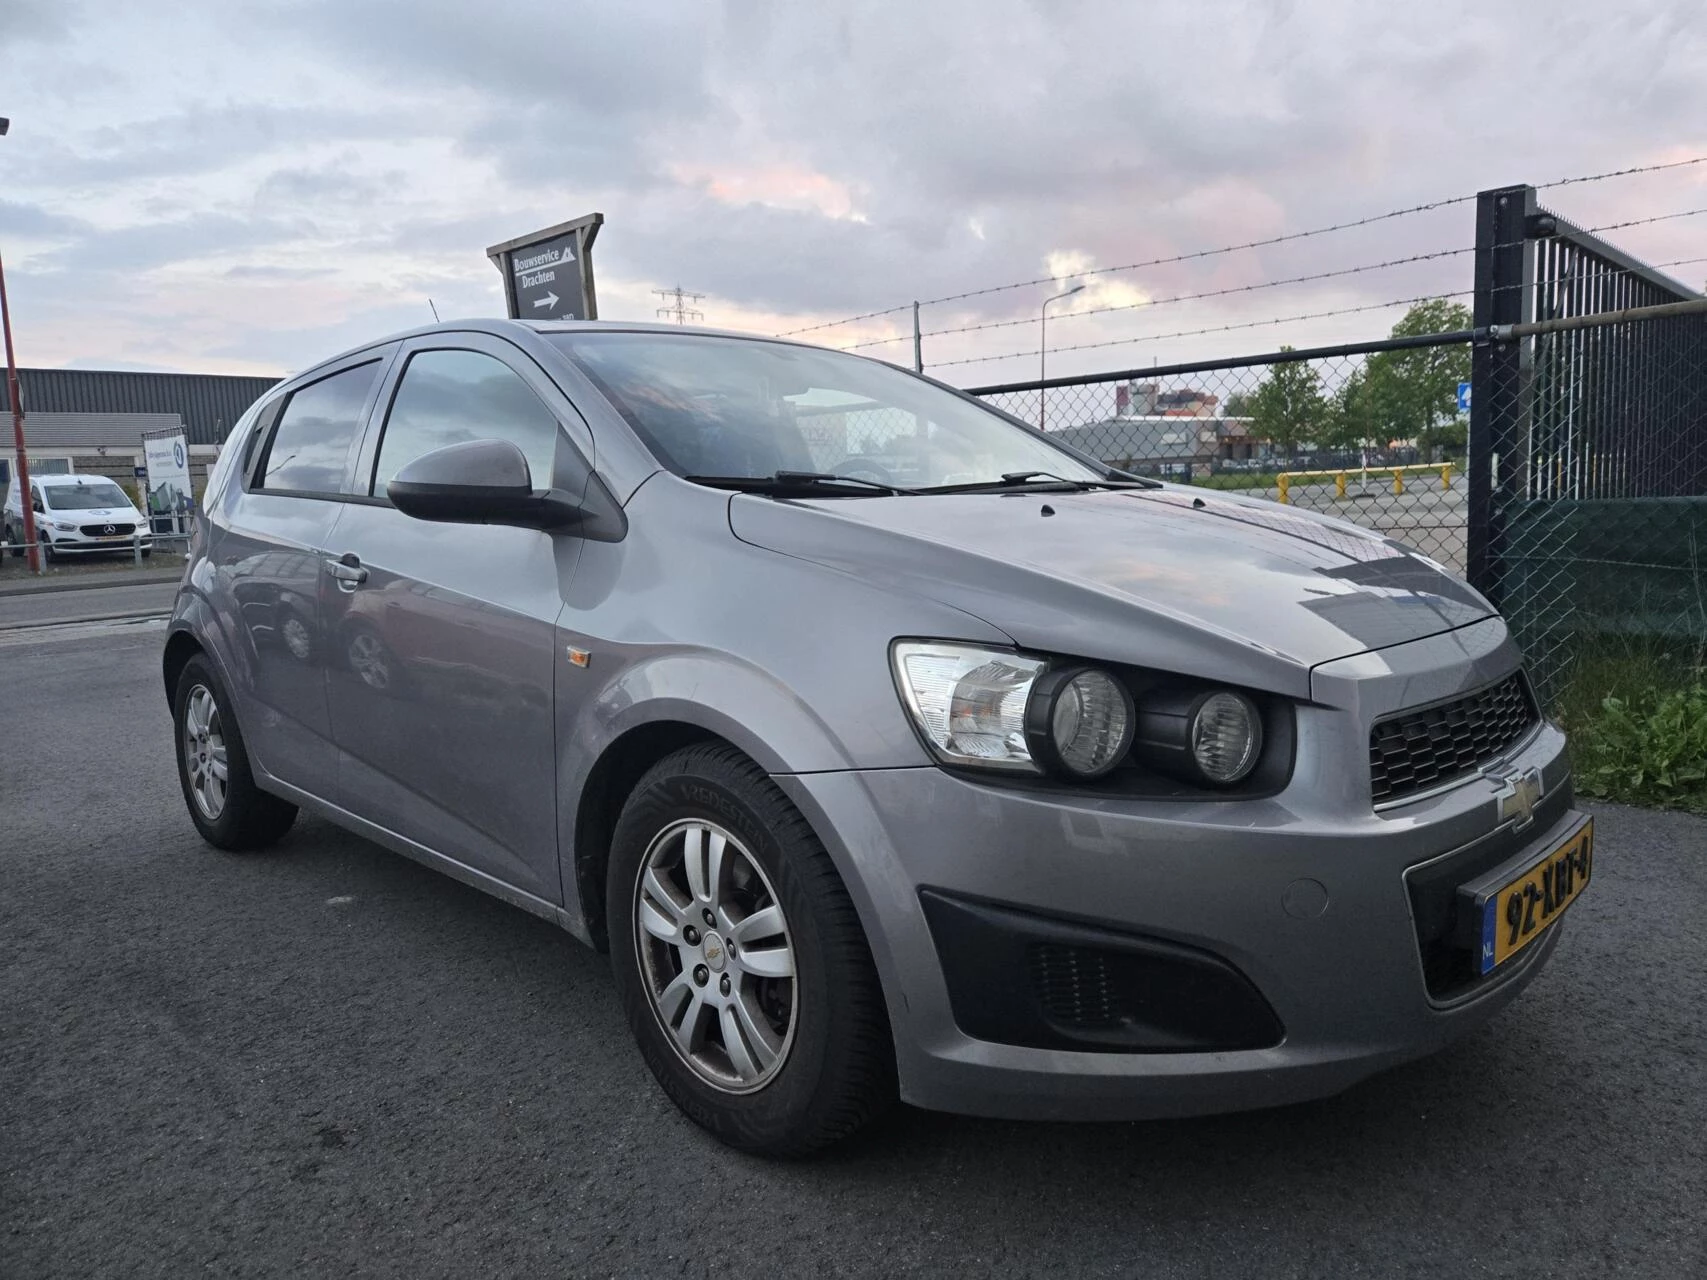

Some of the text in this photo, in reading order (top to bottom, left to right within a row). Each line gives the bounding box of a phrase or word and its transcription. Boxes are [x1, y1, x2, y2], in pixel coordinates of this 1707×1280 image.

[514, 249, 559, 271] Bouwservice
[522, 271, 555, 289] Drachten
[1482, 942, 1493, 961] NL
